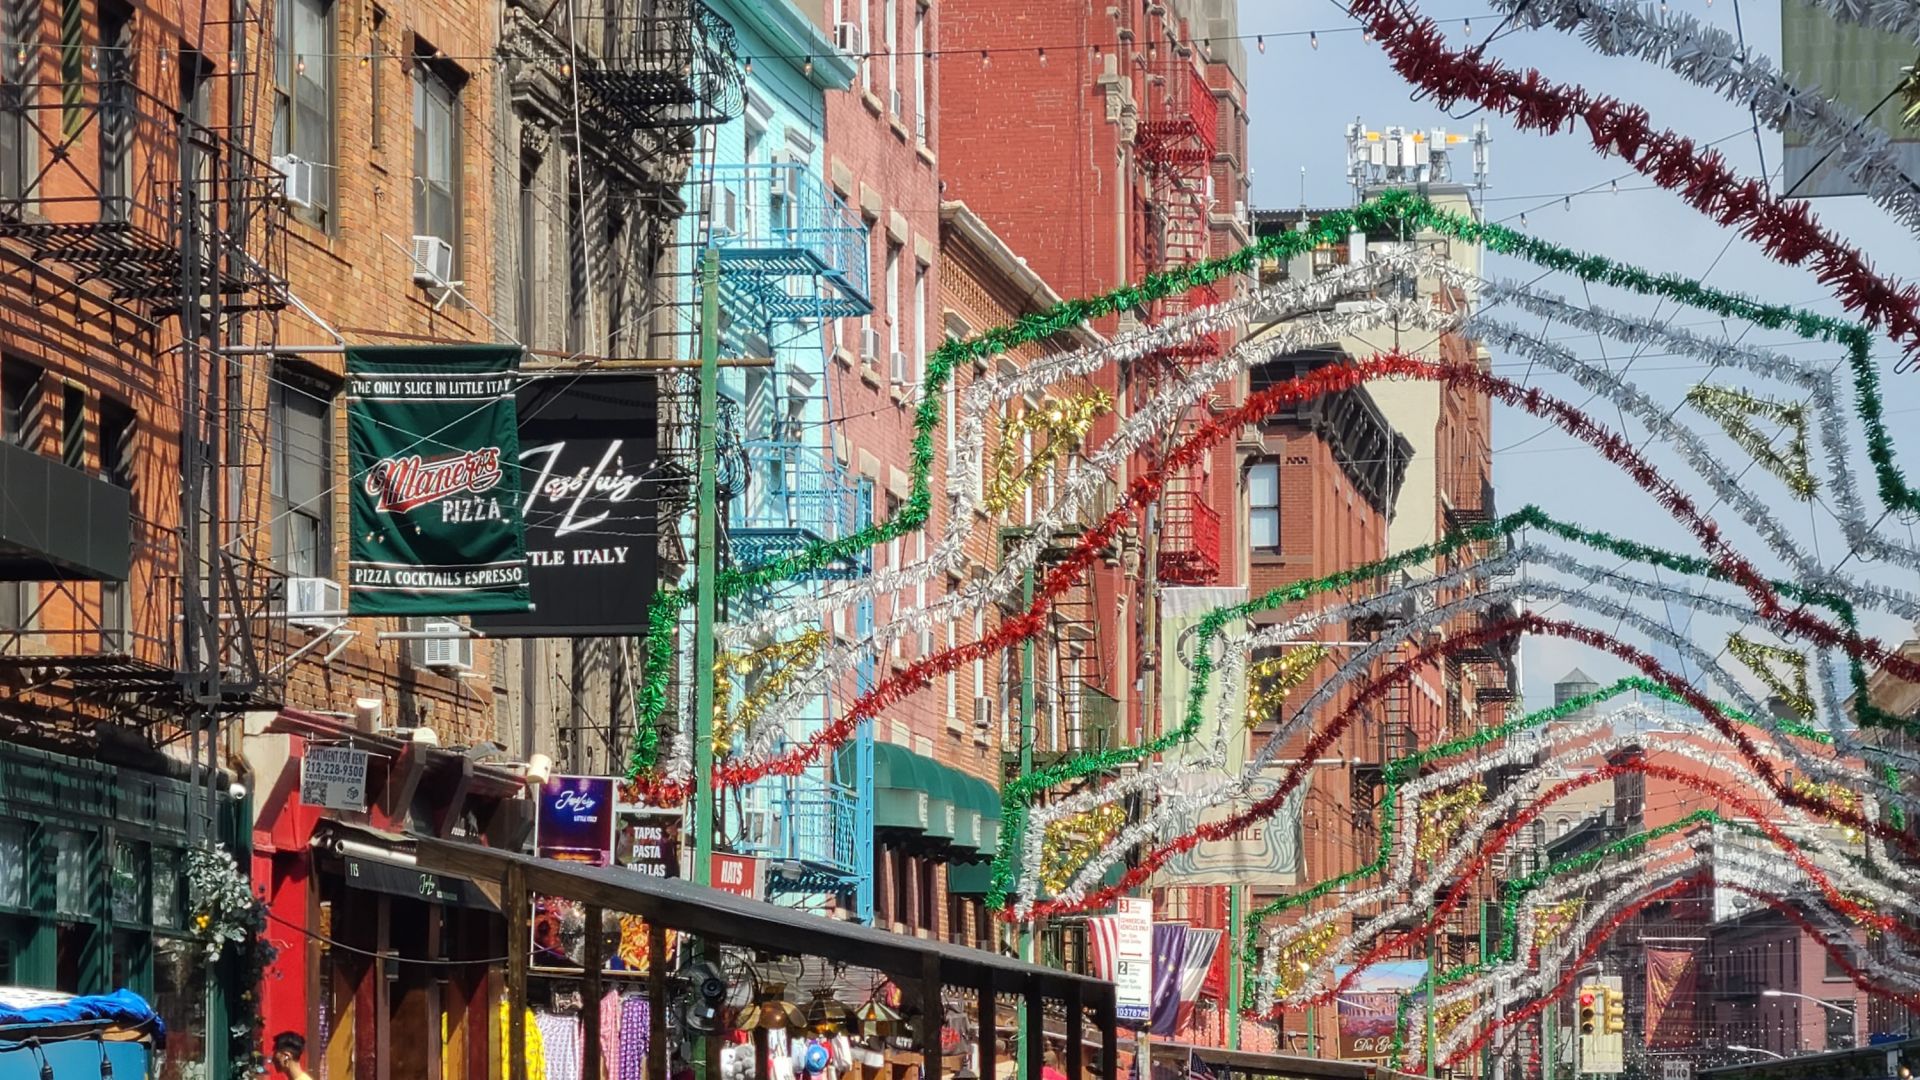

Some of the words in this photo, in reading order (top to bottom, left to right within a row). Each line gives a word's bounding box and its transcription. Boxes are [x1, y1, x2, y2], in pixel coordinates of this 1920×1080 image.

[351, 381, 371, 394] THE
[374, 381, 402, 394] ONLY
[405, 381, 432, 394] SLICE
[435, 381, 447, 394] IN
[449, 381, 484, 395] LITTLE
[442, 496, 501, 523] PIZZA
[572, 546, 629, 565] ITALY
[355, 568, 391, 584] PIZZA
[395, 571, 461, 586] COCKTAILS
[464, 567, 522, 585] ESPRESSO
[340, 751, 351, 764] FOR
[352, 753, 366, 765] RENT
[306, 761, 364, 777] 212-228-9300
[633, 826, 662, 840] TAPAS
[632, 845, 661, 858] PASTA
[720, 860, 743, 885] HATS
[1666, 1068, 1688, 1078] NICO
